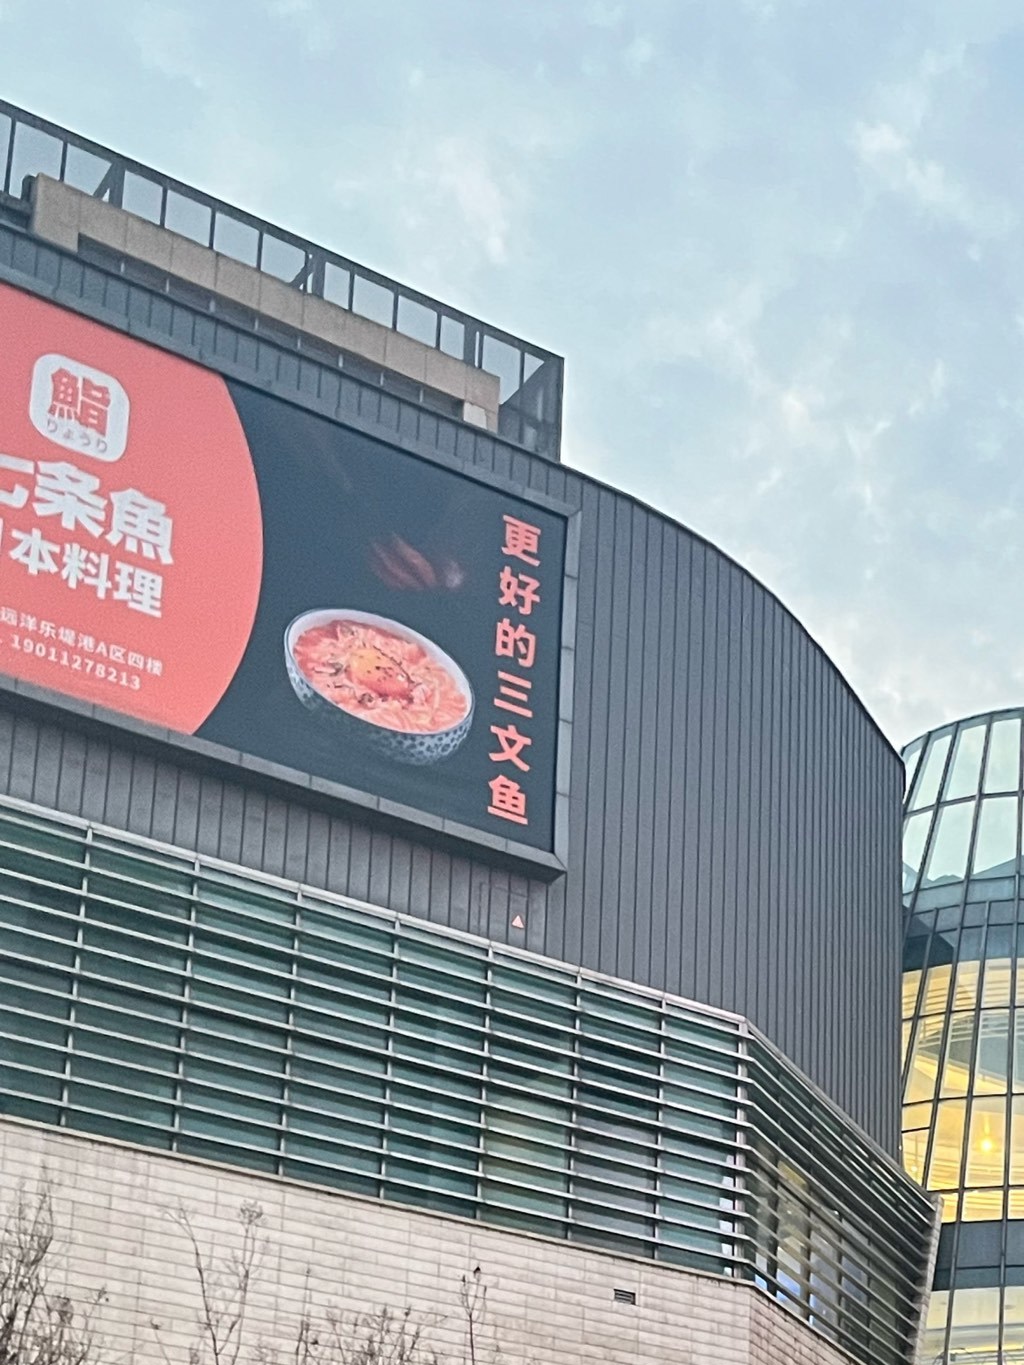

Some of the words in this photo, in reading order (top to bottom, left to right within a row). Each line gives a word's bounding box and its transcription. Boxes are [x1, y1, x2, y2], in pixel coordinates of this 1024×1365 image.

[0, 516, 164, 619] 本料理
[11, 633, 141, 691] 19011278213
[487, 514, 542, 826] 更好的三文鱼
